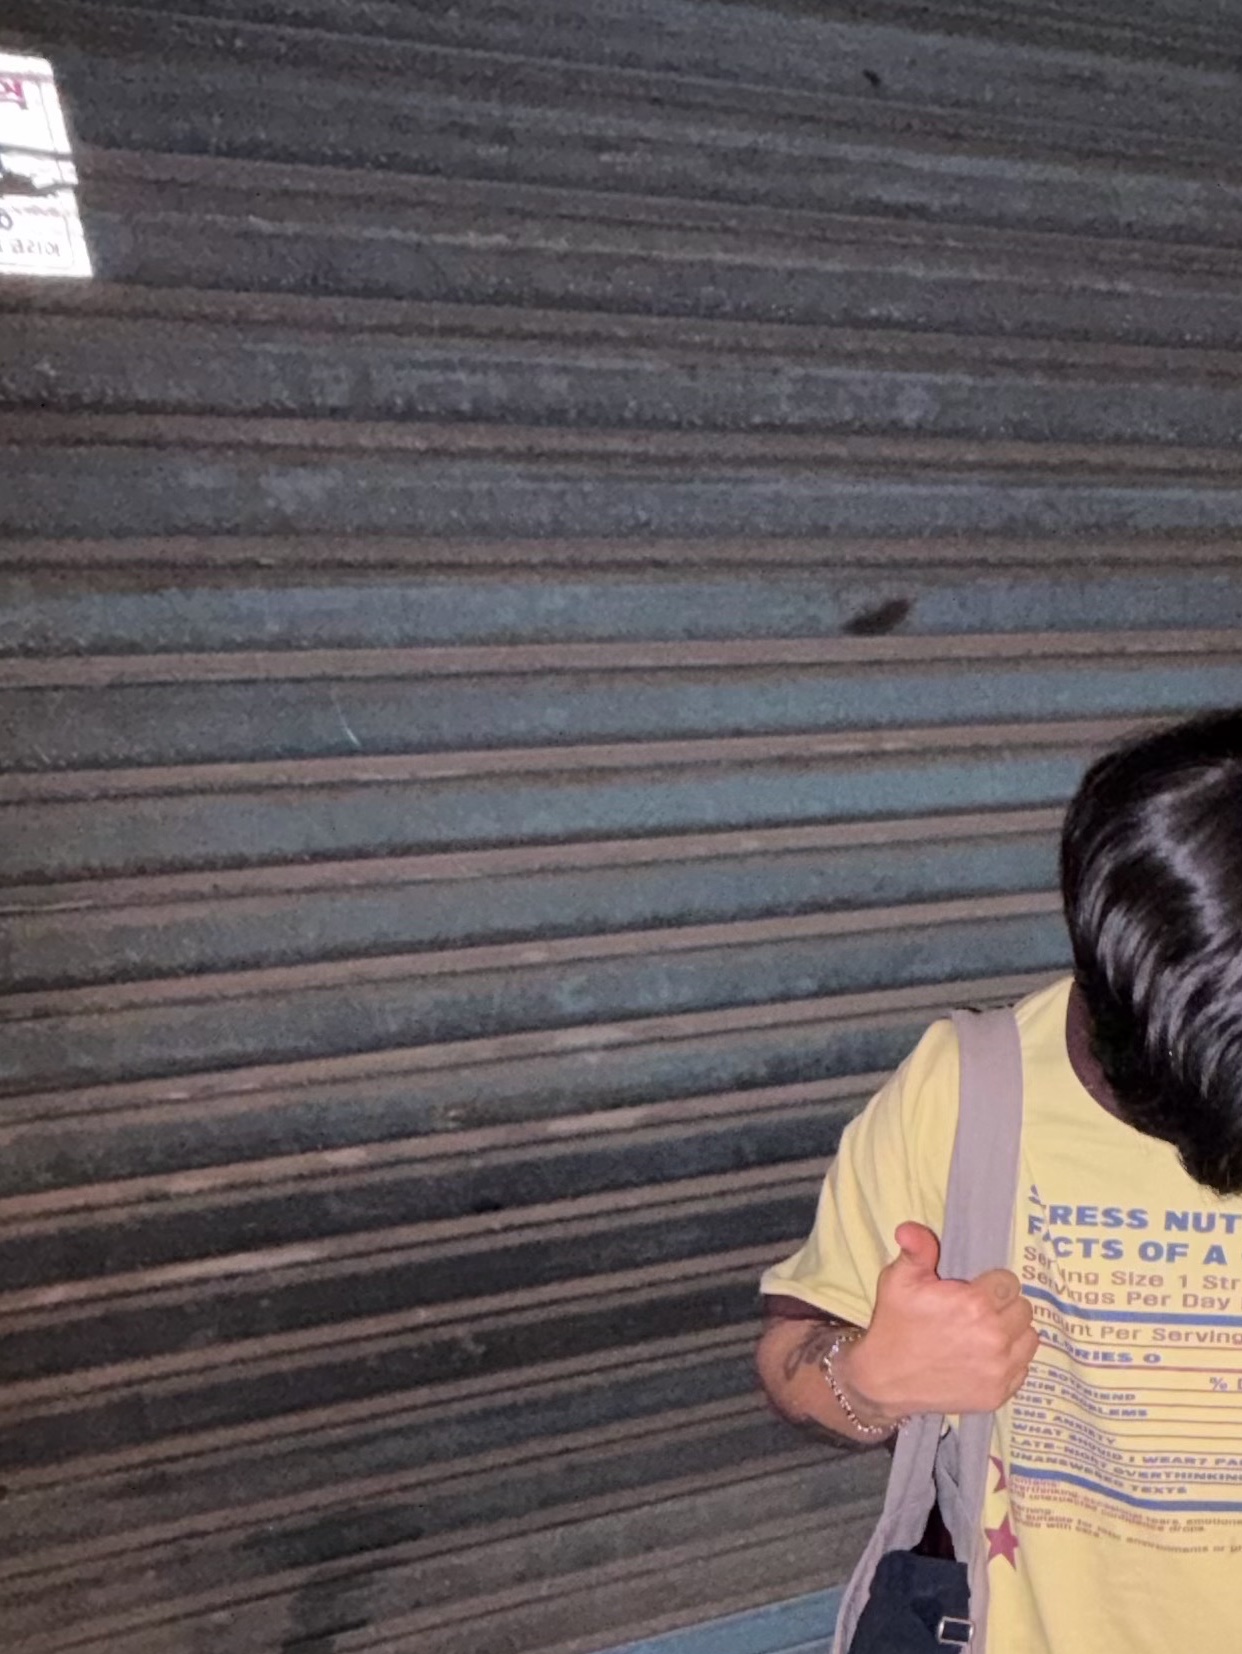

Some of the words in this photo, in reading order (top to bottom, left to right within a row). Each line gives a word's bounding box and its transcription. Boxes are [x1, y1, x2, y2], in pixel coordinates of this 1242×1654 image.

[1138, 1241, 1189, 1264] OF
[1203, 1245, 1227, 1265] A
[1111, 1271, 1164, 1288] Size
[1178, 1274, 1188, 1288] 1
[1127, 1291, 1171, 1306] Per
[1182, 1293, 1231, 1311] Day
[1033, 1304, 1093, 1337] mount
[1101, 1326, 1141, 1340] Per
